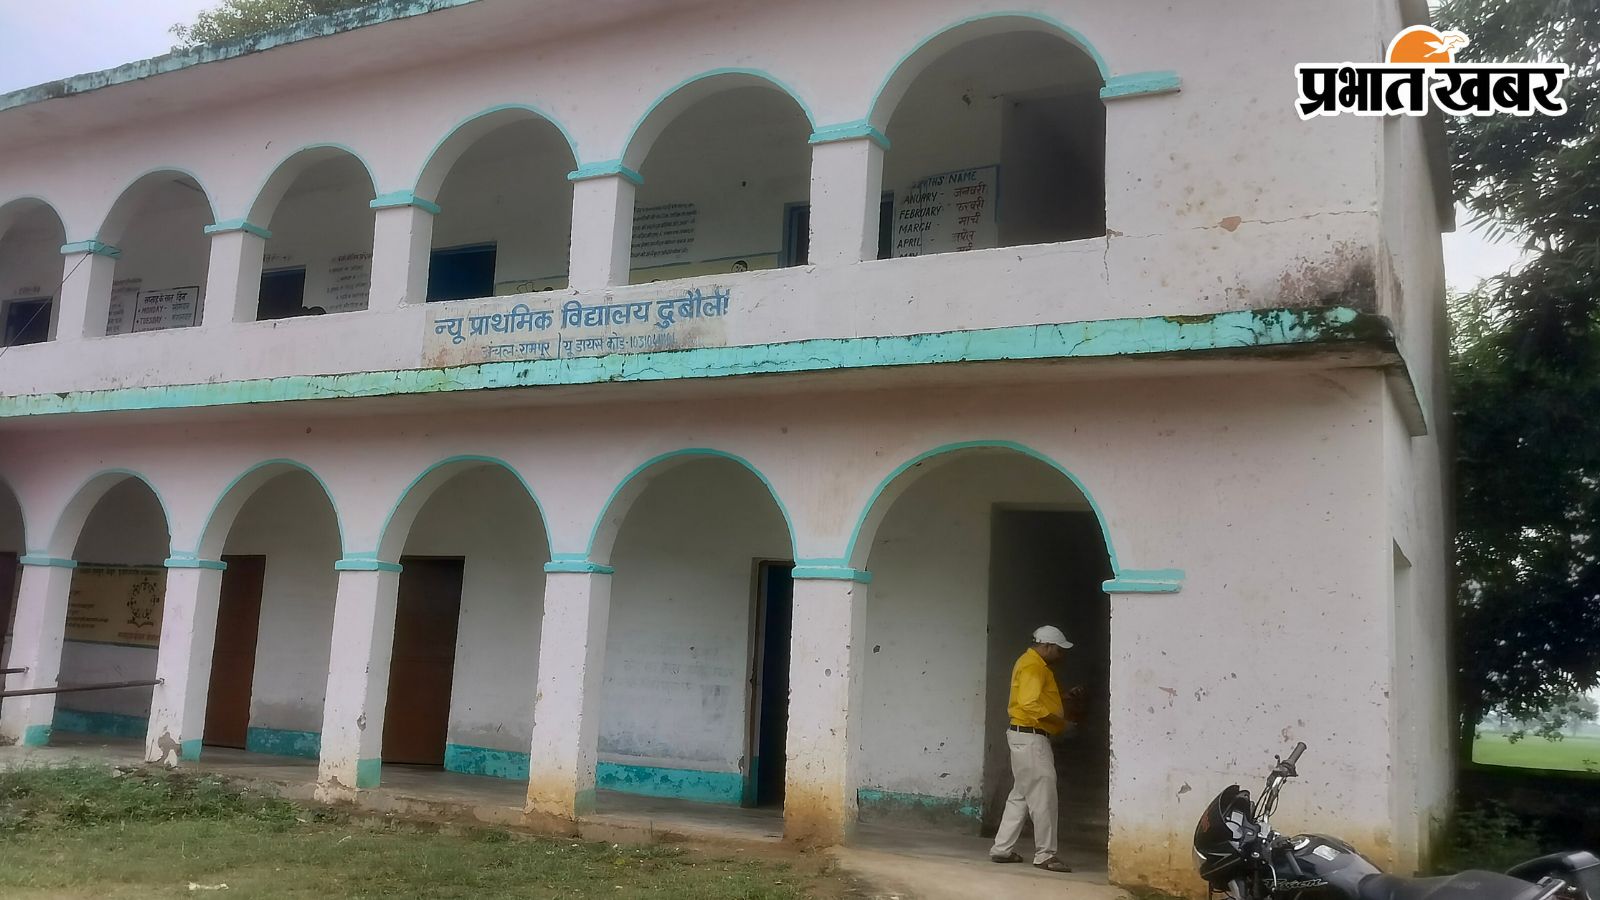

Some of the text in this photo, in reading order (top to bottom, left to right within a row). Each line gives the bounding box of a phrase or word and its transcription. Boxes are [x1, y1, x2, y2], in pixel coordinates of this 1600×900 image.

[948, 171, 977, 184] NAME
[899, 206, 942, 220] FEBRUARY
[898, 221, 932, 235] MARCH
[896, 238, 922, 249] APRIL
[434, 318, 466, 345] न्यू
[469, 303, 554, 336] प्राथमिक
[560, 300, 654, 330] विद्यालय
